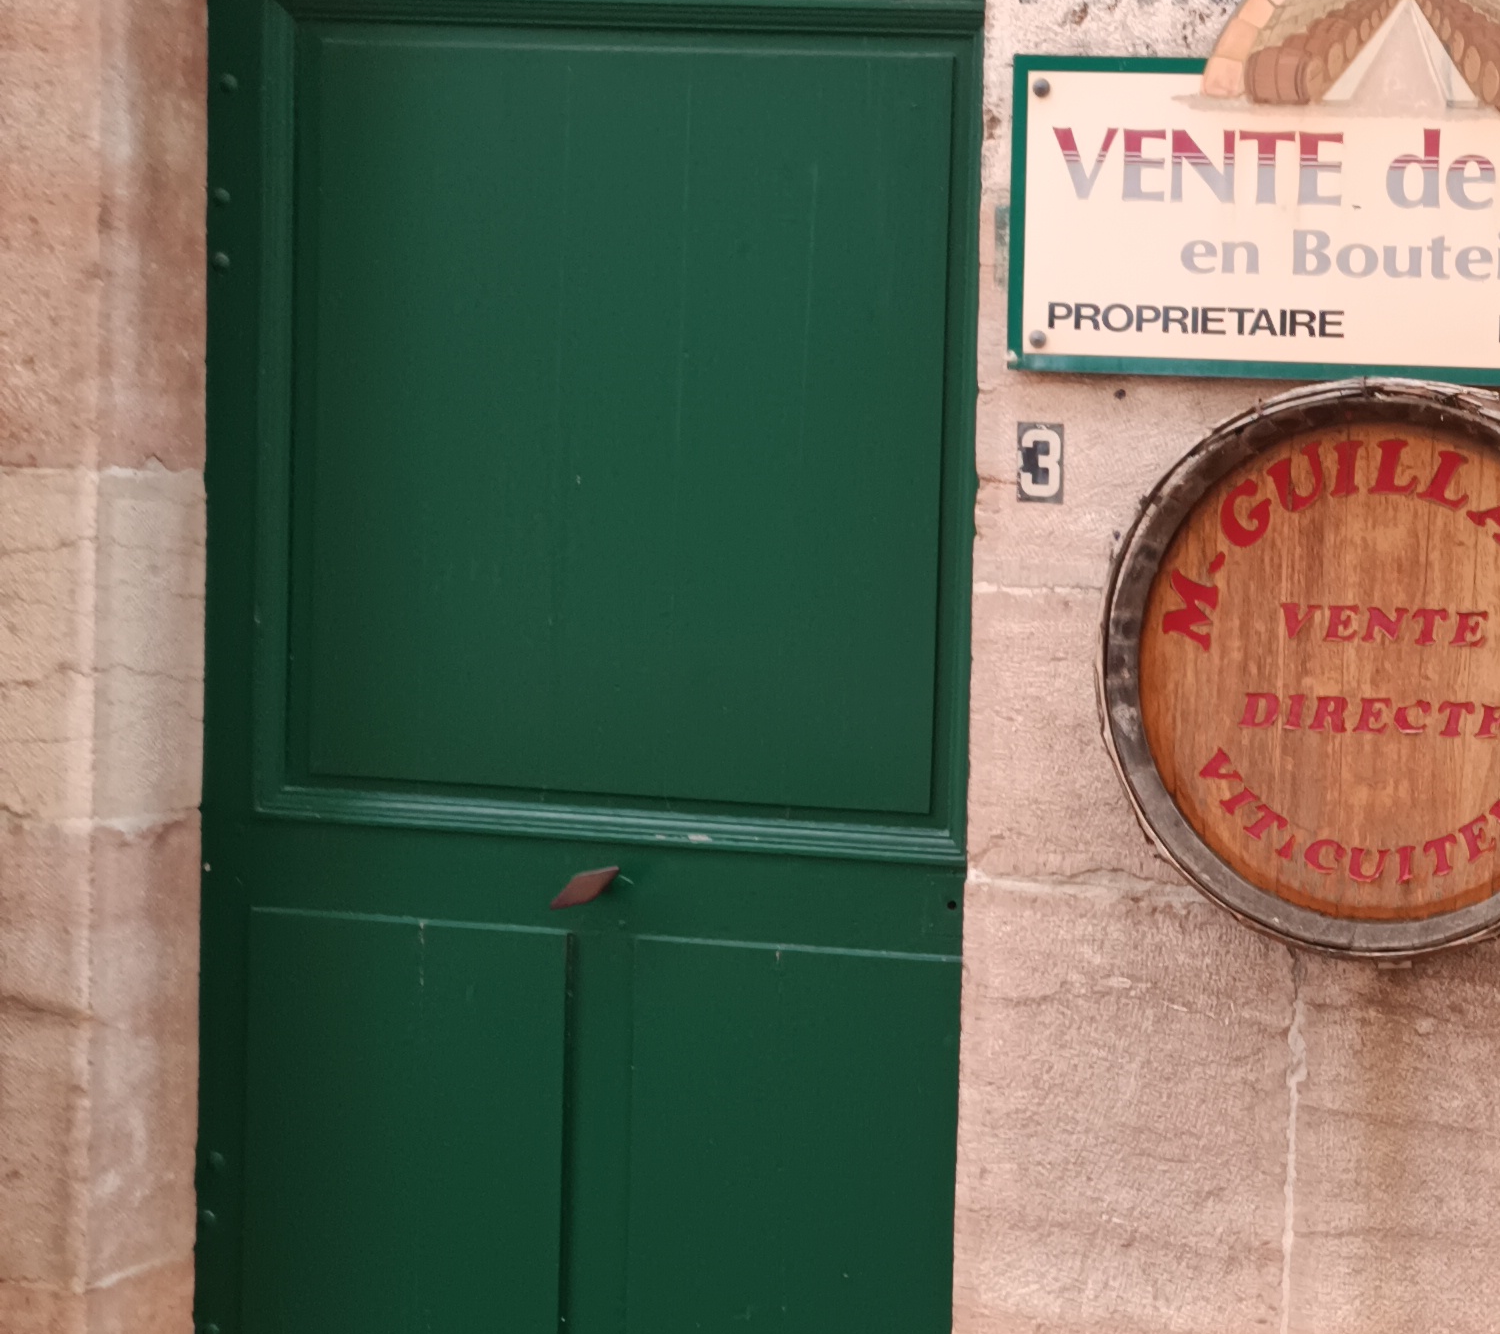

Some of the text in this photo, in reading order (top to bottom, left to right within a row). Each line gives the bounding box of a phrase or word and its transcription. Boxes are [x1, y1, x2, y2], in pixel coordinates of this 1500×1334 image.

[1052, 126, 1344, 207] VENTE
[1385, 128, 1496, 211] de
[1179, 238, 1260, 275] en
[1047, 300, 1345, 339] PROPRIETAIRE
[1020, 429, 1062, 497] 3
[1279, 602, 1489, 648] VENTE
